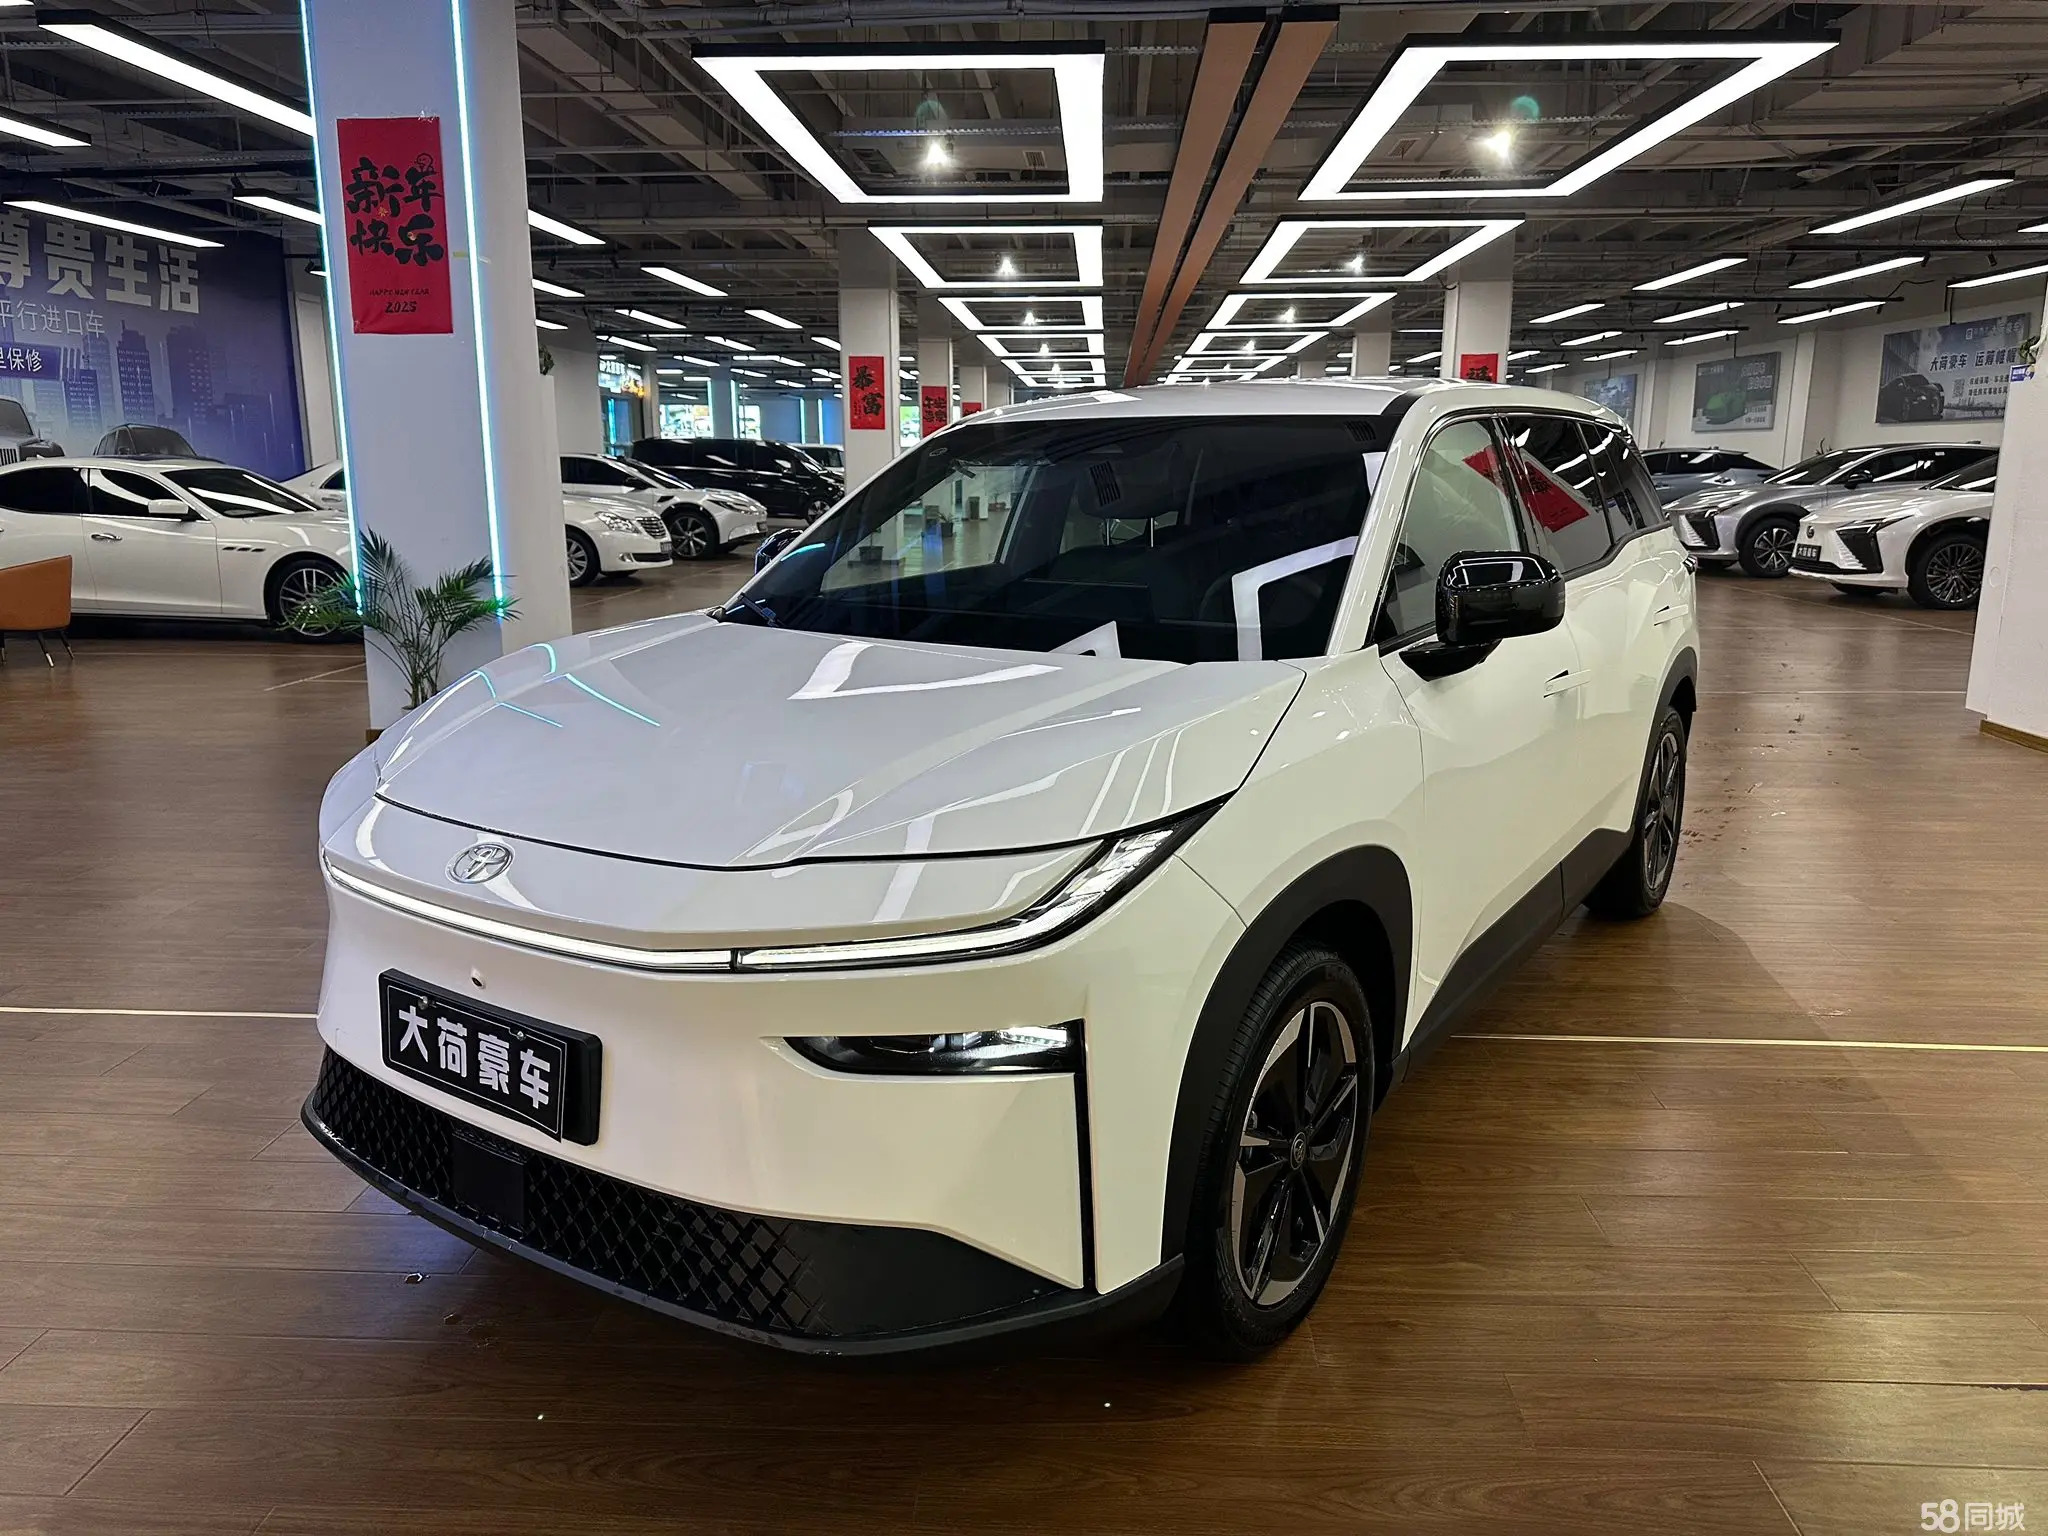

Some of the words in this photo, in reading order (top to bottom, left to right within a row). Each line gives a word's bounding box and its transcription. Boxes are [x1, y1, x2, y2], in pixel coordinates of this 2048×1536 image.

[346, 157, 443, 217] 新年
[0, 211, 200, 314] 尊贵生活
[350, 214, 445, 266] 快乐
[0, 299, 106, 338] 平行进口车
[384, 301, 418, 313] 2025
[398, 1005, 551, 1110] 大荷豪车
